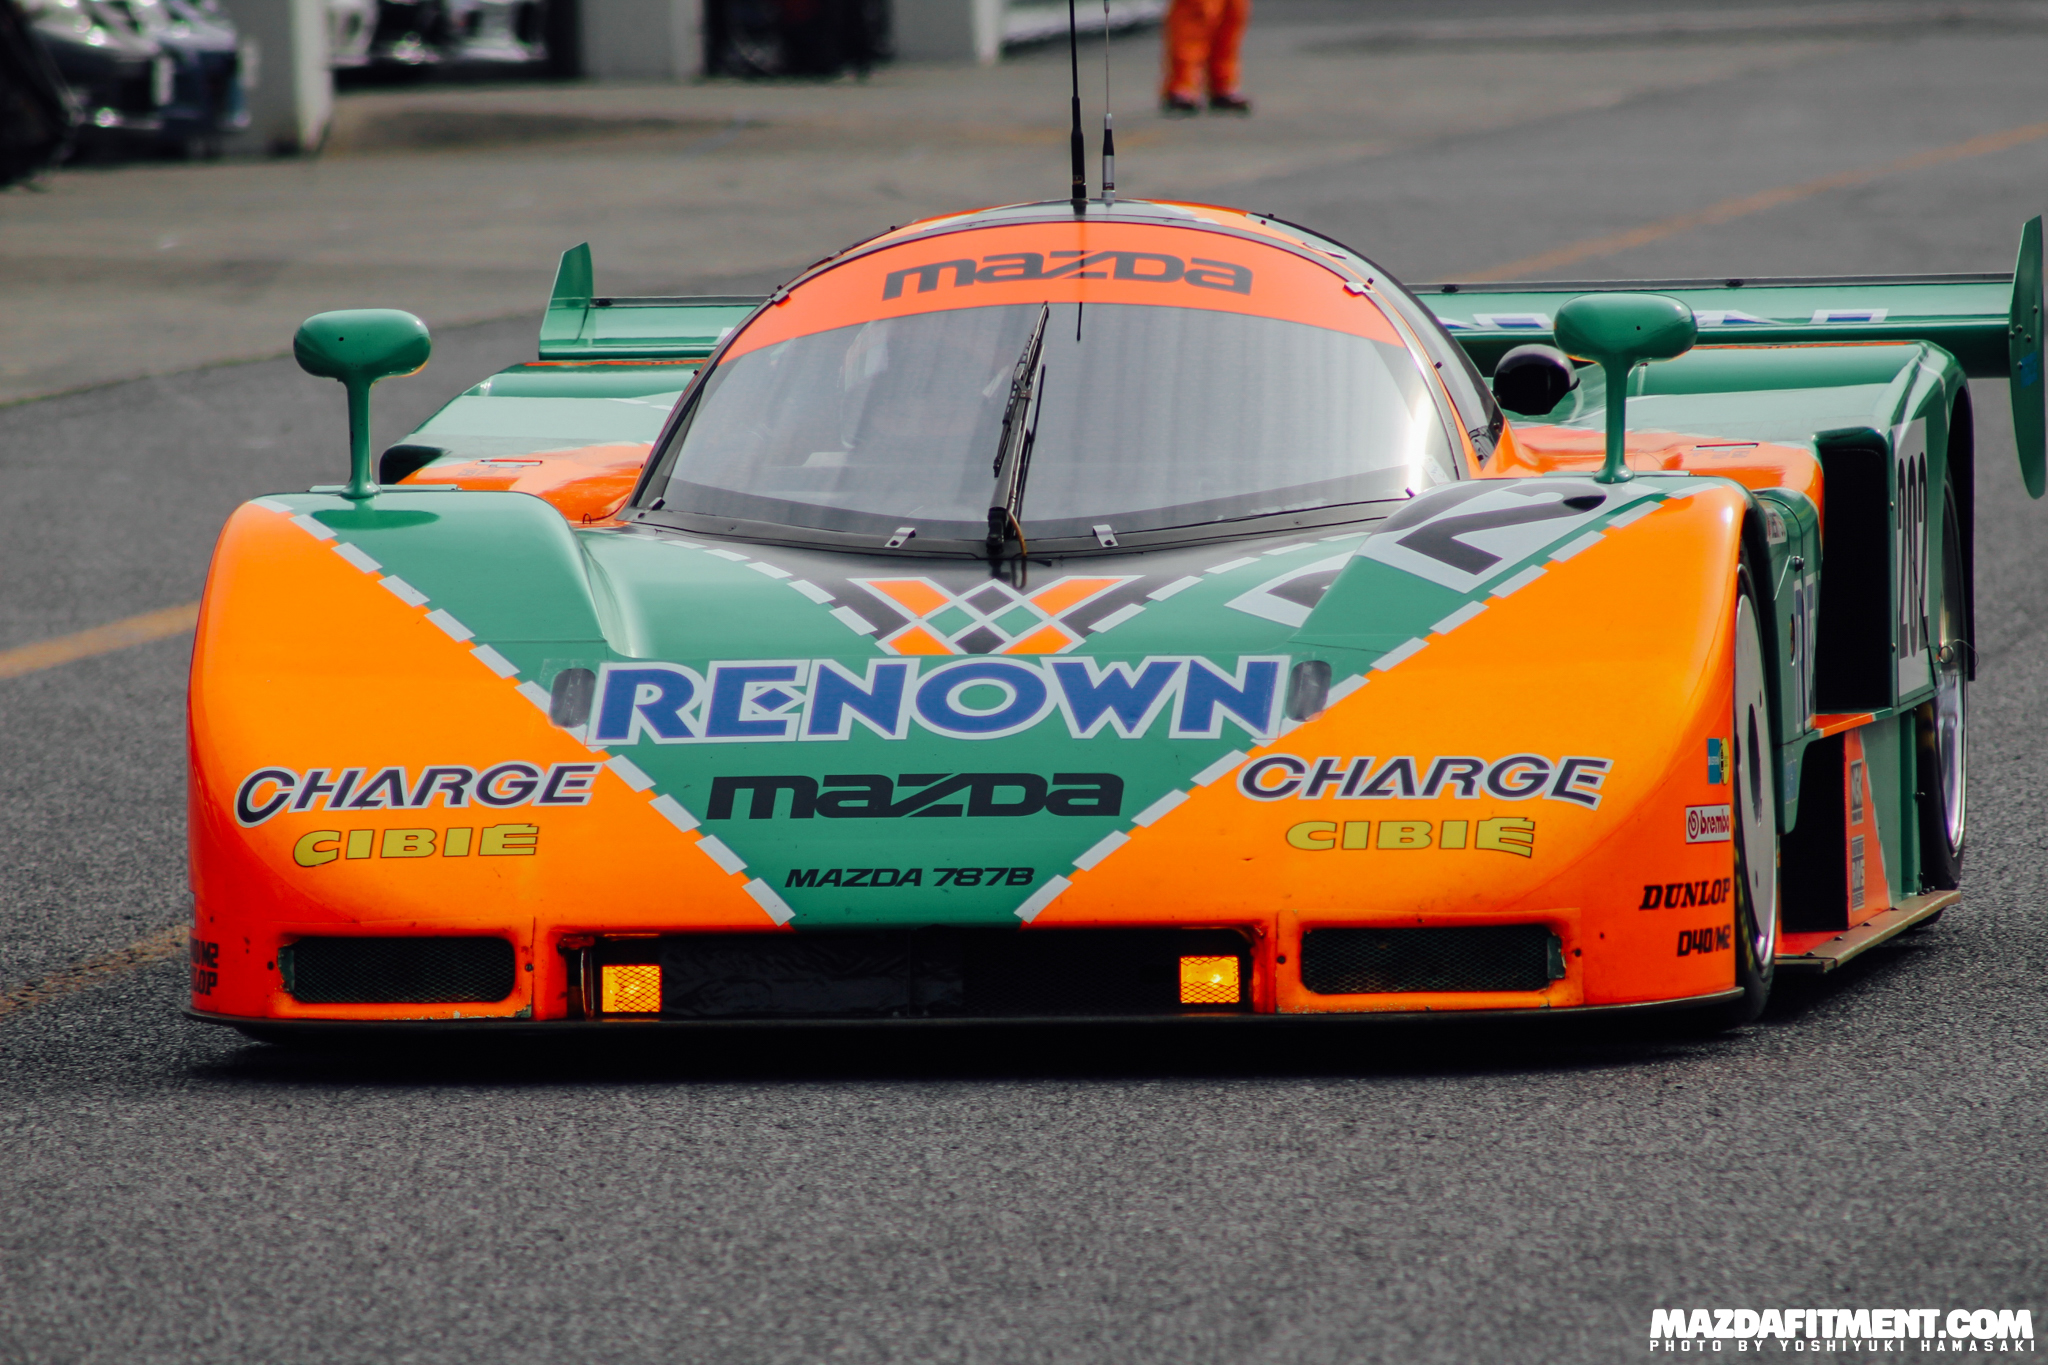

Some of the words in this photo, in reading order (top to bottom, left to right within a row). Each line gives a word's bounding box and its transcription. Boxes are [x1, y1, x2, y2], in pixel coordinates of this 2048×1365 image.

[588, 655, 1291, 745] RENOWN
[235, 761, 602, 828] CHARGE
[1236, 753, 1614, 811] CHARGE
[785, 868, 922, 888] MAZDA
[932, 867, 1035, 887] 787B
[1638, 877, 1731, 911] DUNLOP
